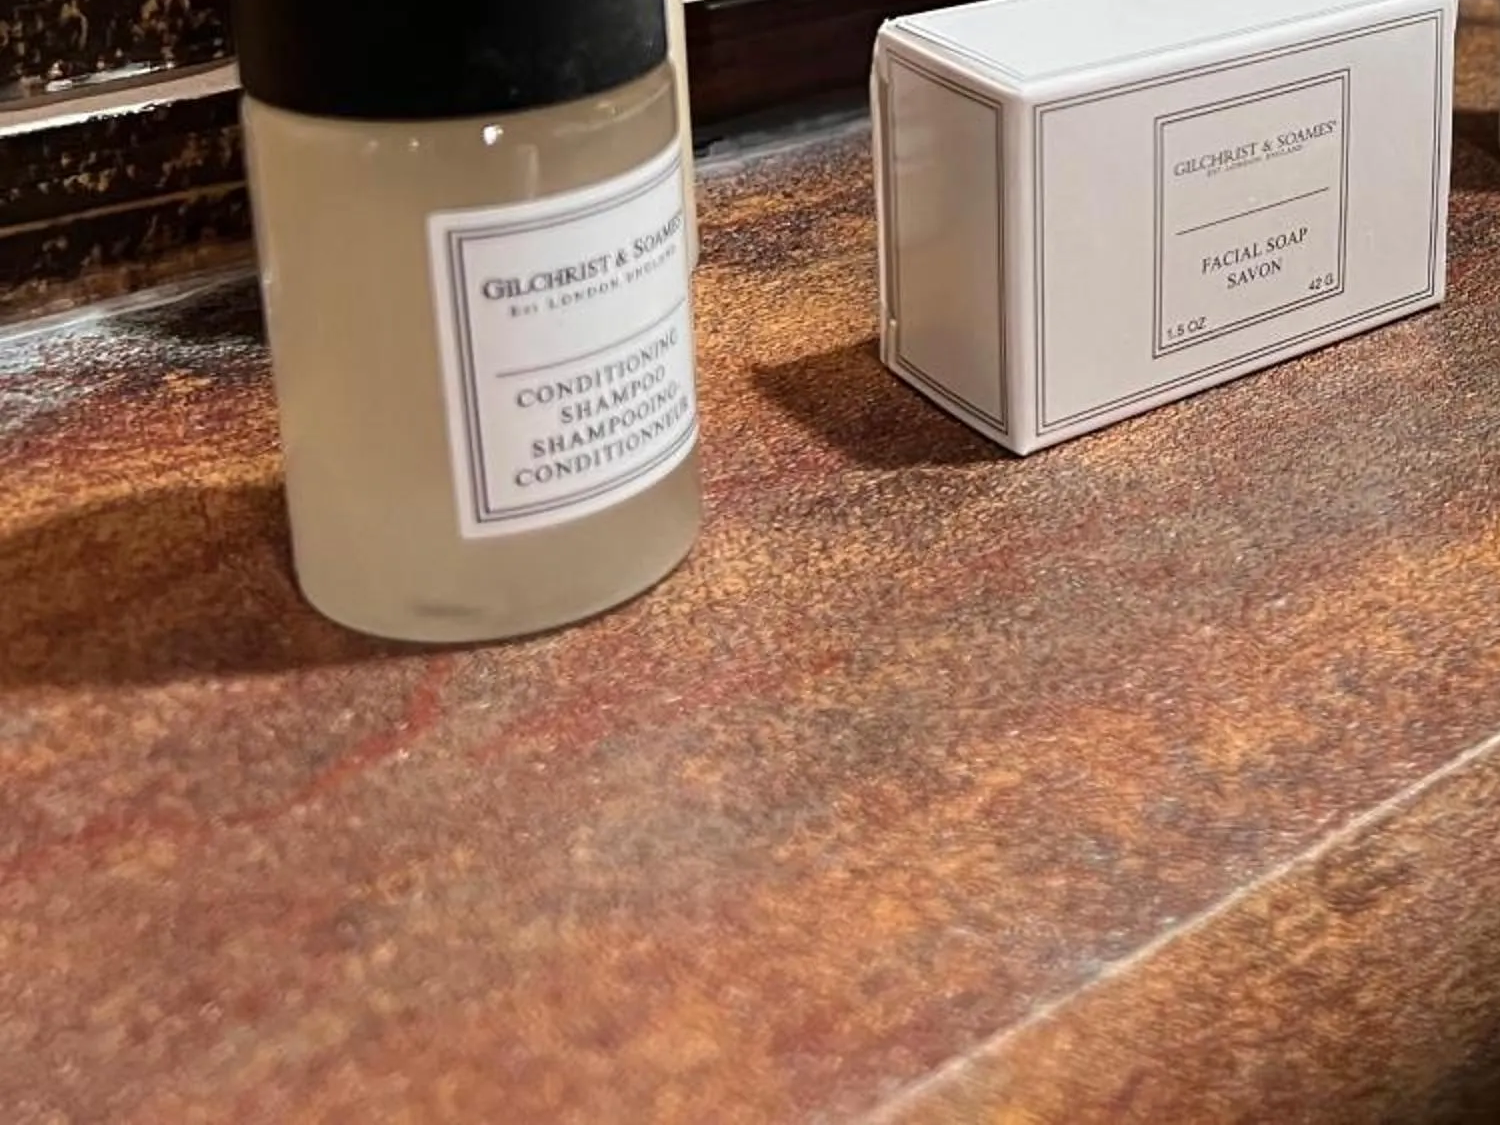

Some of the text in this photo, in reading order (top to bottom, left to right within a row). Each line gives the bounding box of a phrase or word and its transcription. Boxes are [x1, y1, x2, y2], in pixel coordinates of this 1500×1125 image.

[1173, 141, 1258, 177] GILCHRIST
[1262, 139, 1274, 153] &
[1276, 120, 1336, 148] SOAMES
[482, 253, 612, 301] GILCHRIST
[615, 247, 628, 269] &
[1201, 226, 1309, 275] FACIAL SOAP
[1226, 258, 1283, 290] SAVON
[1308, 277, 1323, 290] 42
[516, 327, 679, 409] CONDITIONING
[560, 364, 666, 424] SHAMPOO
[532, 380, 680, 459] SHAMPOOING
